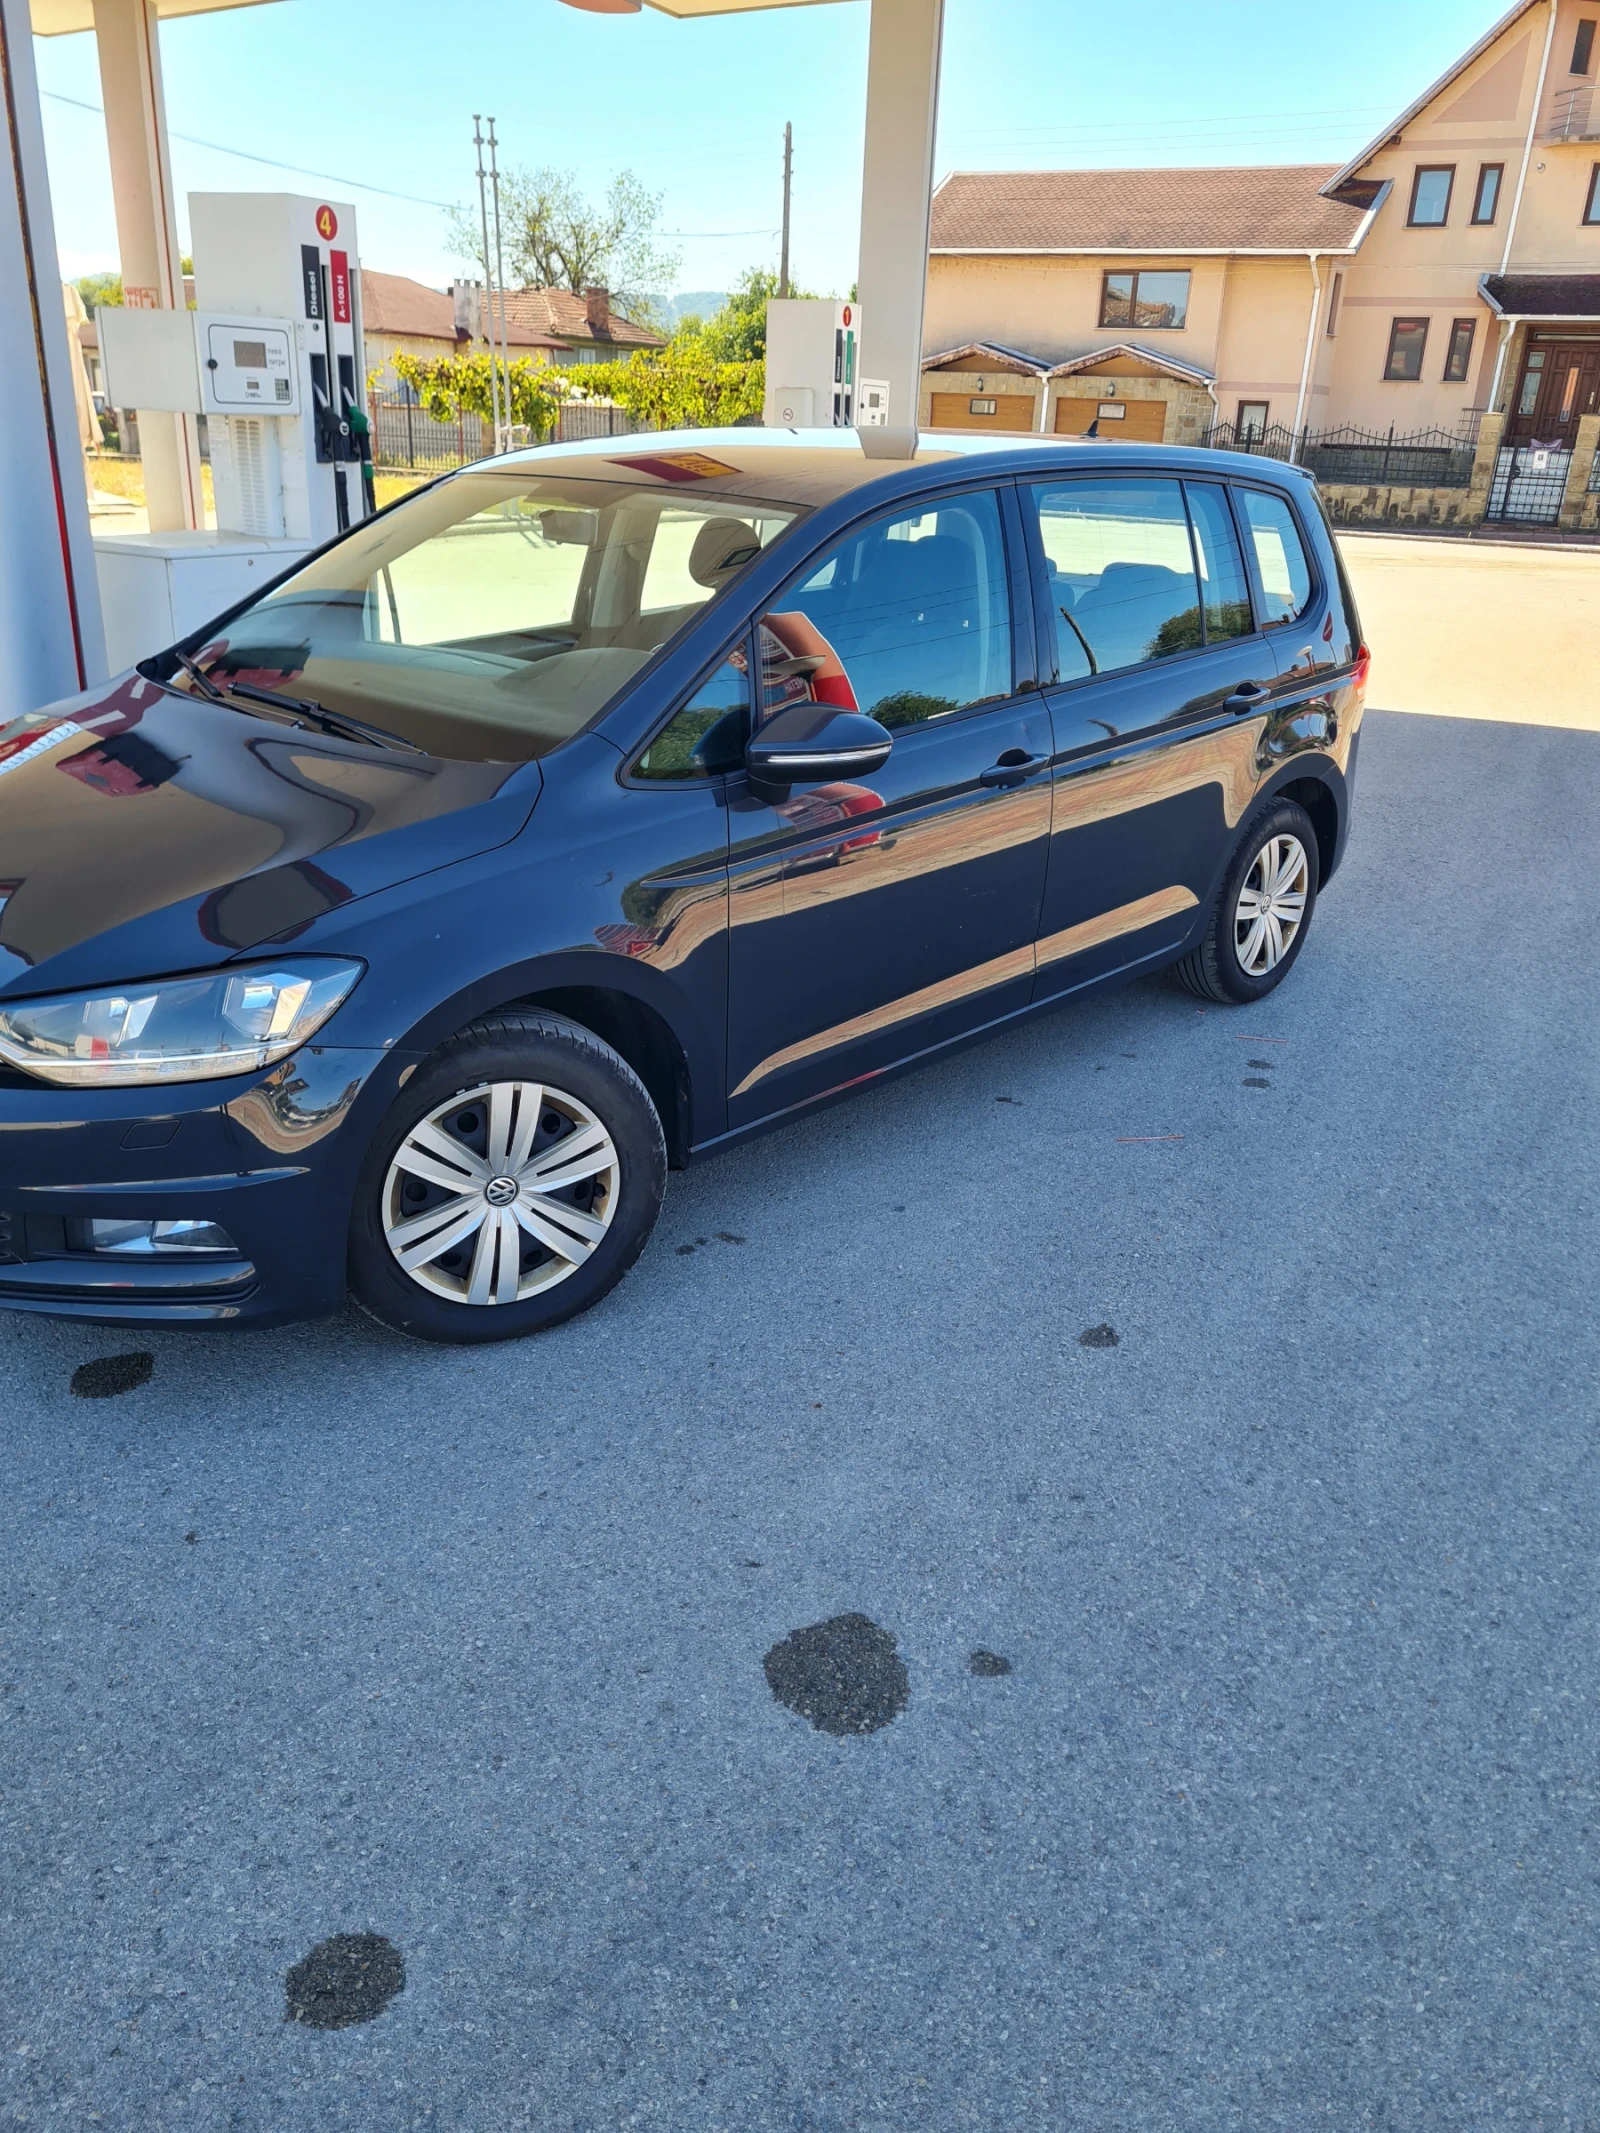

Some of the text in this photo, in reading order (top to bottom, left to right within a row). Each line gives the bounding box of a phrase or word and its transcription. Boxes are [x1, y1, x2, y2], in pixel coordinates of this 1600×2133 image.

[320, 210, 332, 236] 4
[308, 271, 318, 316] Diesel
[844, 309, 849, 325] 1
